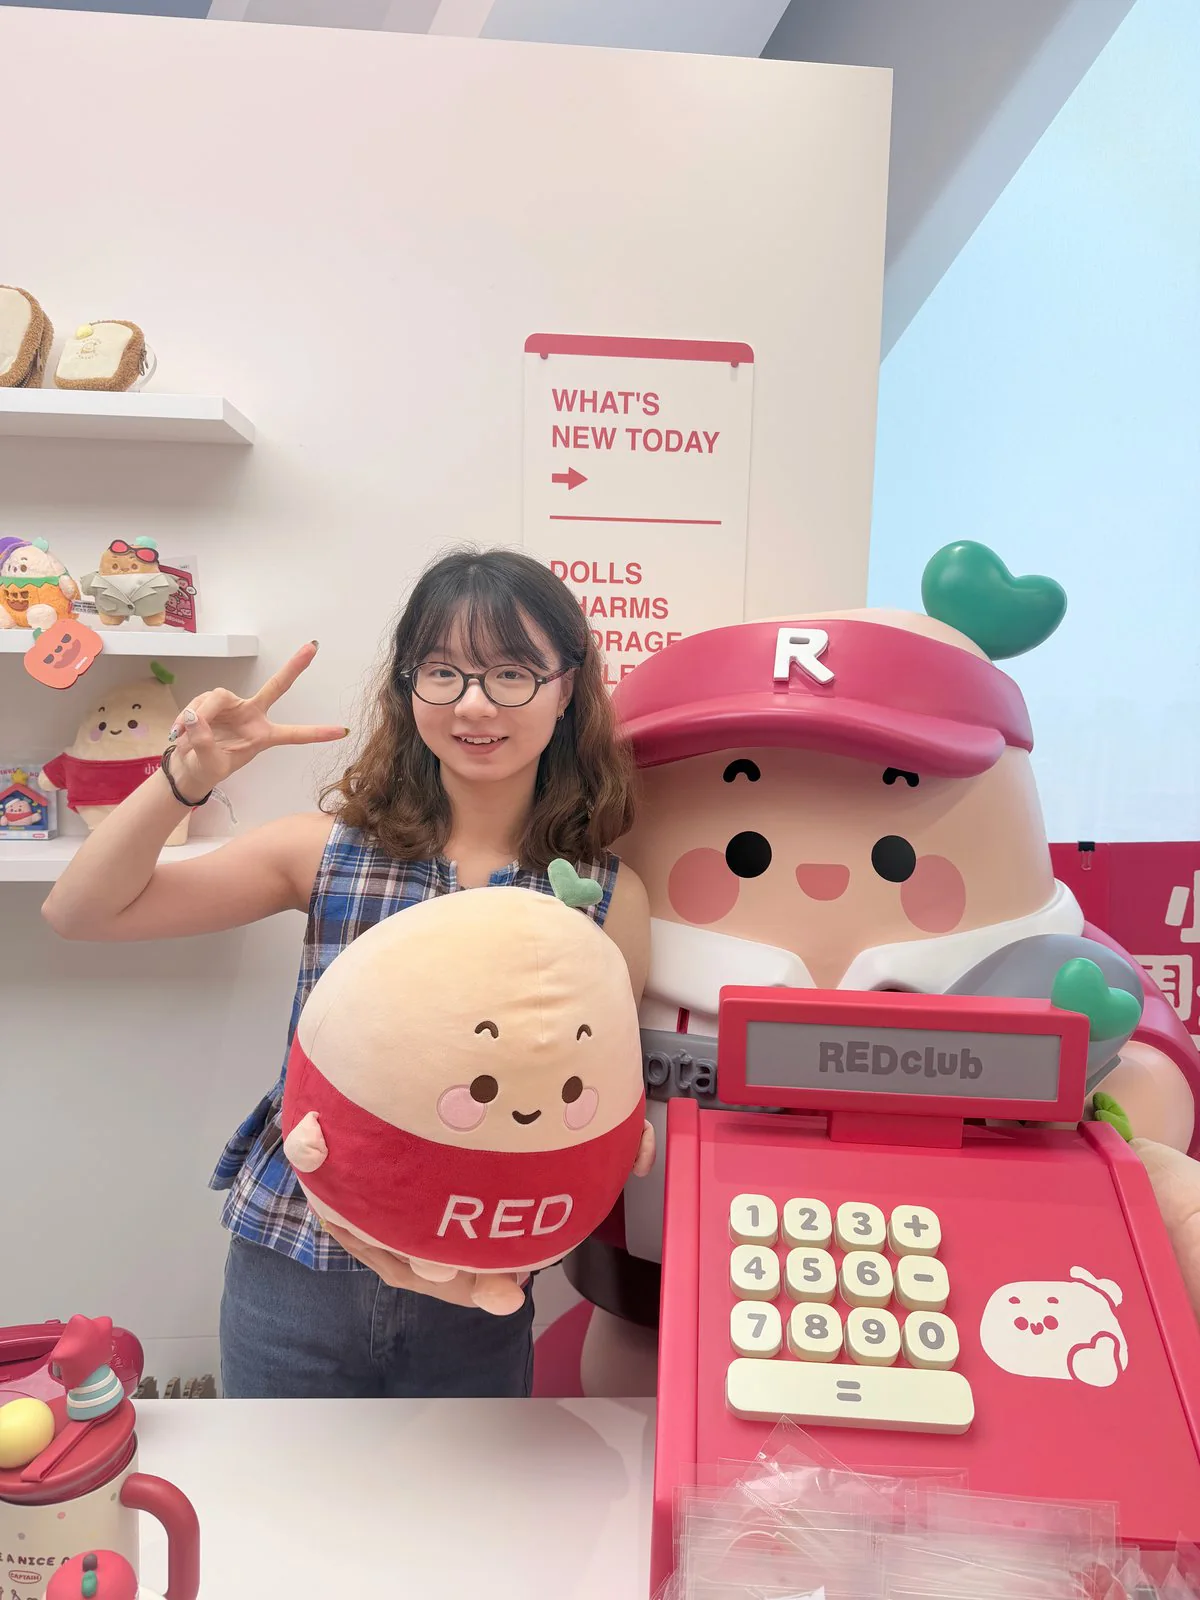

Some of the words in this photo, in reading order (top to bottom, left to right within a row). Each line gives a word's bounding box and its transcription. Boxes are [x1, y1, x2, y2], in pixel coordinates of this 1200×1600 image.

[552, 388, 660, 416] WHAT'S
[552, 425, 617, 450] NEW
[625, 428, 720, 454] TODAY
[550, 560, 643, 585] DOLLS
[580, 595, 669, 619] HARMS
[774, 627, 835, 684] R
[818, 1040, 983, 1080] REDclub
[436, 1193, 573, 1239] RED
[746, 1204, 760, 1227] 1
[798, 1207, 819, 1231] 2
[852, 1211, 873, 1236] 3
[743, 1256, 766, 1280] 4
[802, 1257, 822, 1282] 5
[856, 1260, 880, 1286] 6
[747, 1312, 767, 1339] 7
[804, 1313, 829, 1340] 8
[861, 1318, 886, 1345] 9
[918, 1321, 945, 1350] 0
[18, 1556, 56, 1566] NICE
